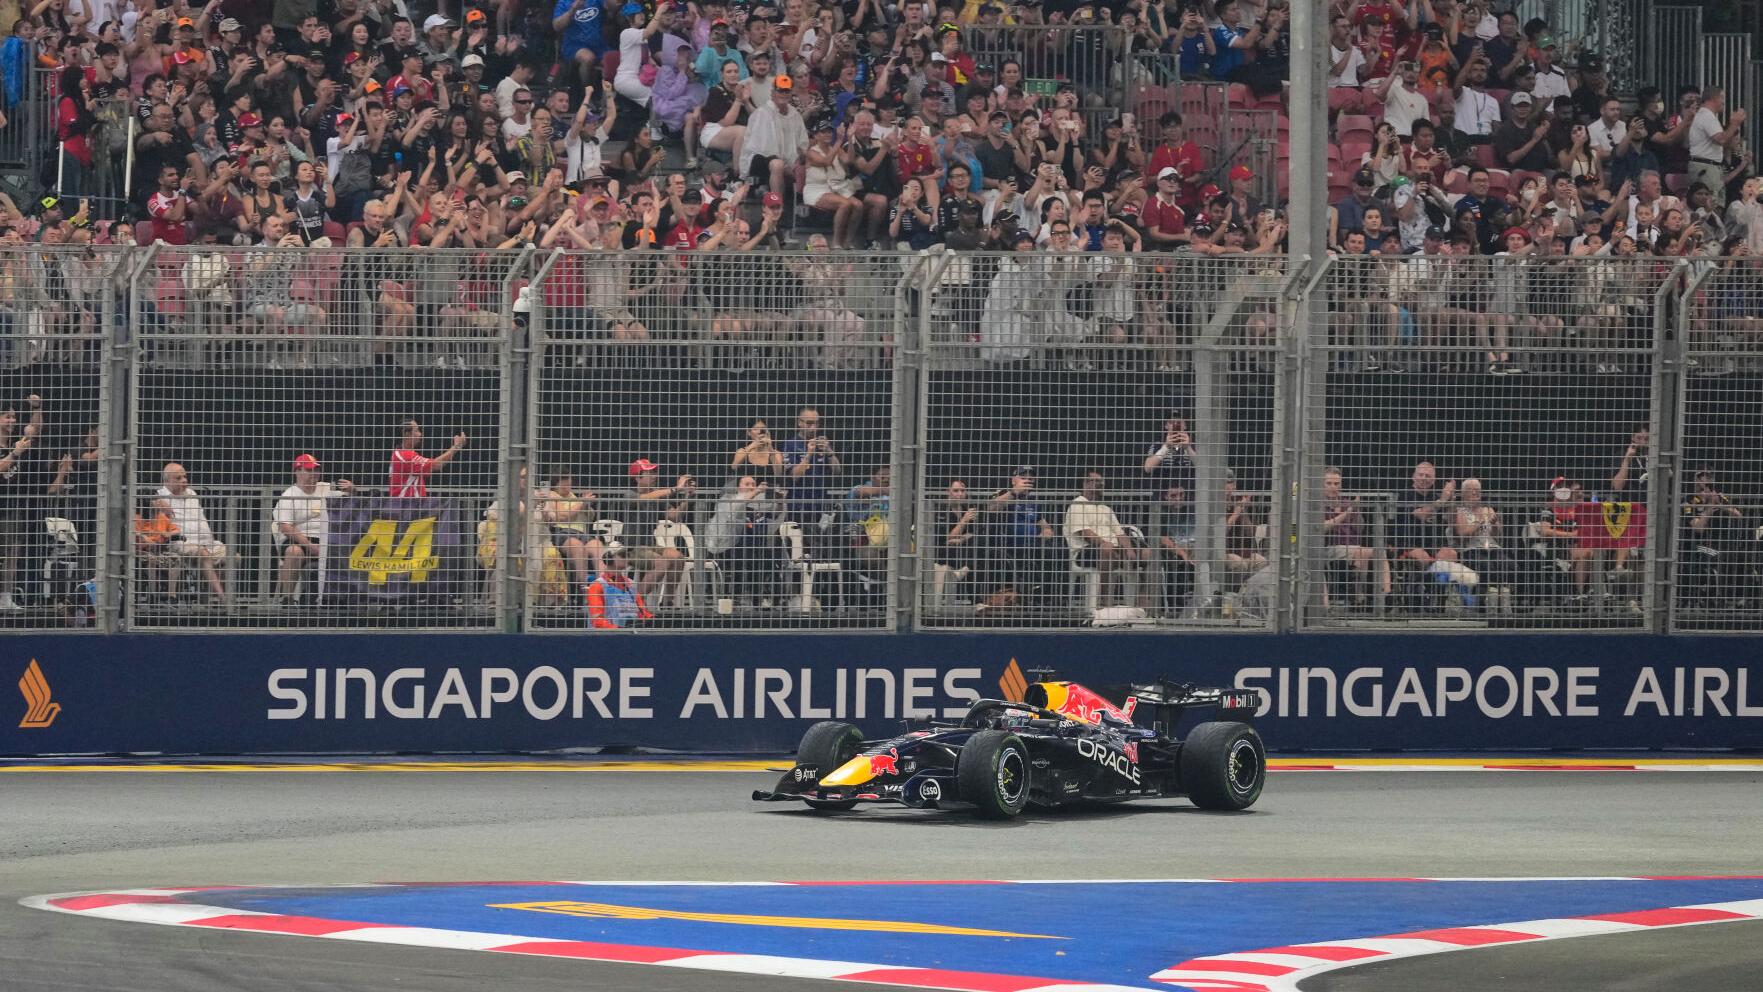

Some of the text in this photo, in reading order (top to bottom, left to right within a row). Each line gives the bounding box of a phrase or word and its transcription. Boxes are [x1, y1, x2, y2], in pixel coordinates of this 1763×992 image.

[349, 517, 437, 585] 44
[352, 558, 434, 570] LEWIS HAMILTON
[267, 665, 982, 721] SINGAPORE AIRLINES
[1222, 694, 1247, 709] Mobil
[1234, 665, 1600, 719] SINGAPORE
[1077, 738, 1141, 786] ORACLE
